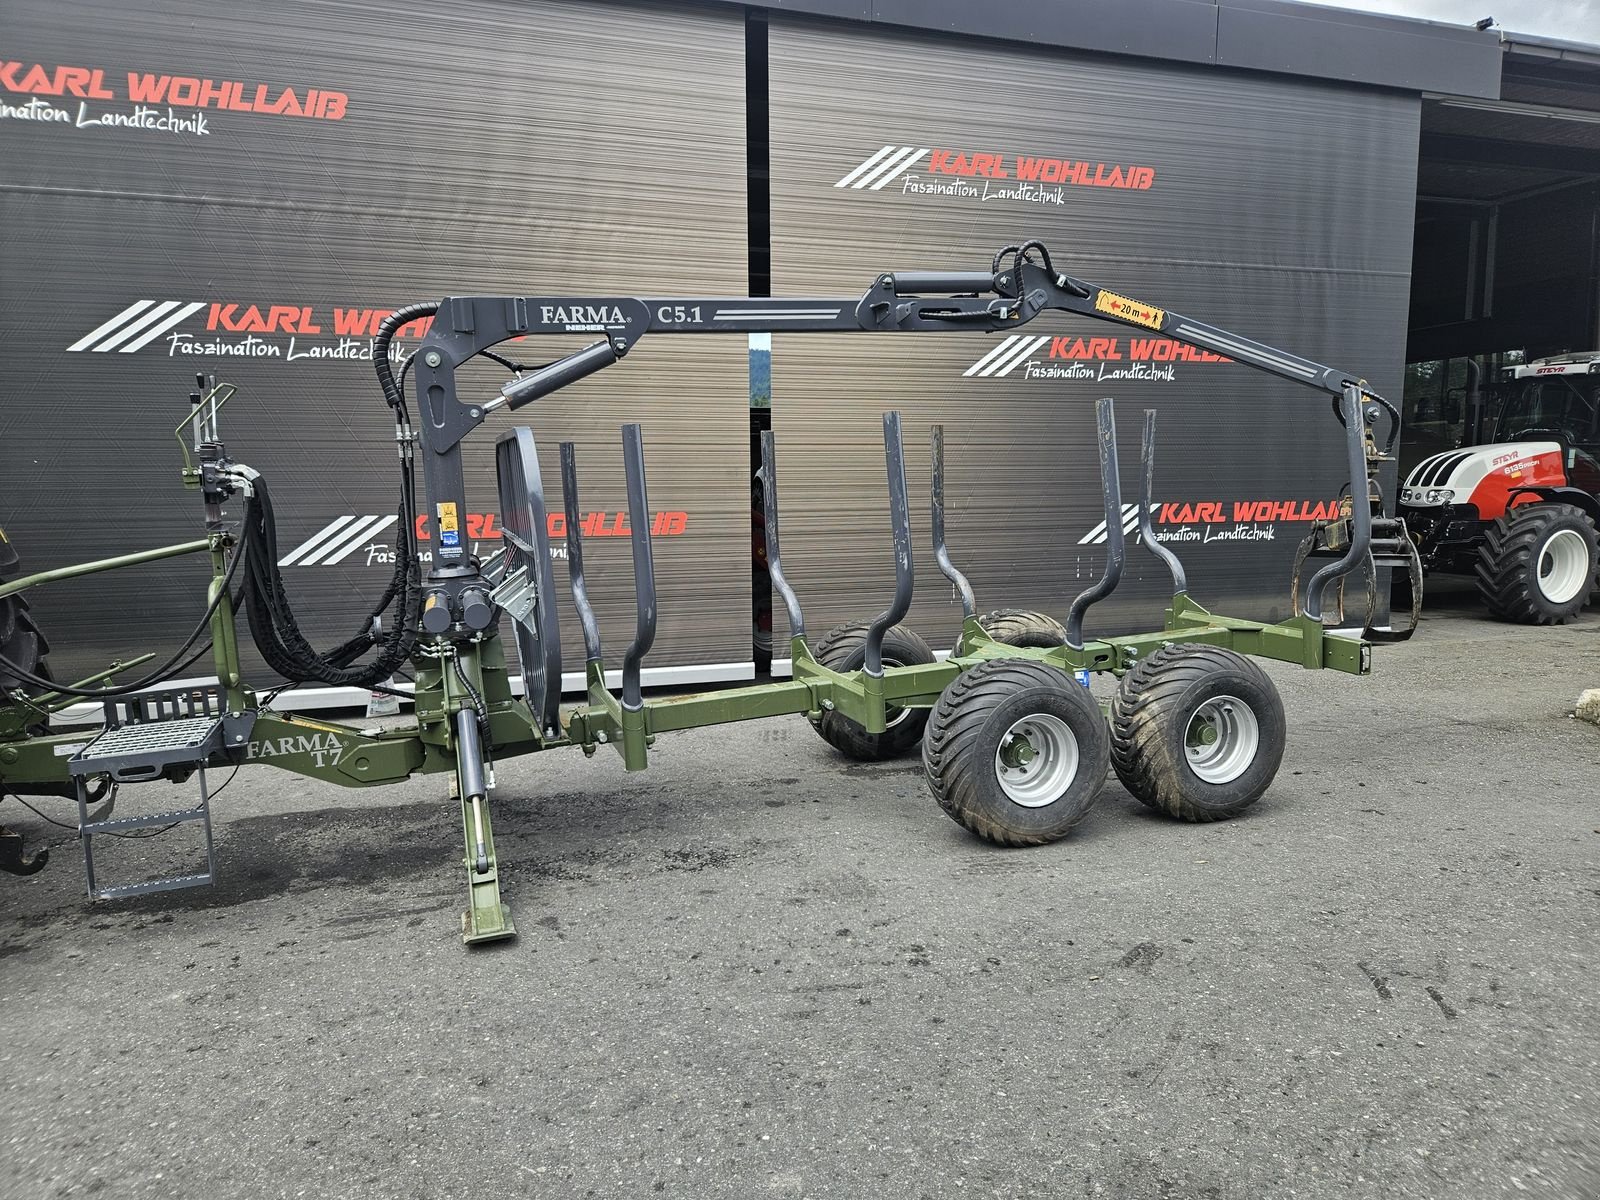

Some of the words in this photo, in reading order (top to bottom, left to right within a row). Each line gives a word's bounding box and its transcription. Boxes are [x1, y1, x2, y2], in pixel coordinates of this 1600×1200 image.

[0, 96, 71, 123] nation
[75, 101, 210, 135] Landtechnik
[928, 149, 1009, 178] KARL
[902, 173, 978, 197] Faszination
[982, 180, 1065, 205] Landtechnik
[206, 303, 321, 334] KARL
[1120, 303, 1131, 315] 20
[1132, 310, 1140, 318] m
[166, 331, 281, 357] Faszination
[286, 334, 406, 363] Landtecik
[1048, 336, 1122, 361] KARL
[1129, 338, 1236, 363] WOHLL
[1024, 360, 1095, 380] Faszination
[1098, 361, 1176, 382] Landtechnik
[1536, 366, 1566, 375] STEYR
[1492, 450, 1519, 466] STEYR
[1159, 502, 1227, 524] KARL
[1233, 500, 1341, 522] WOHLLAI
[1203, 523, 1275, 544] Landtechnik
[311, 747, 343, 768] T7
